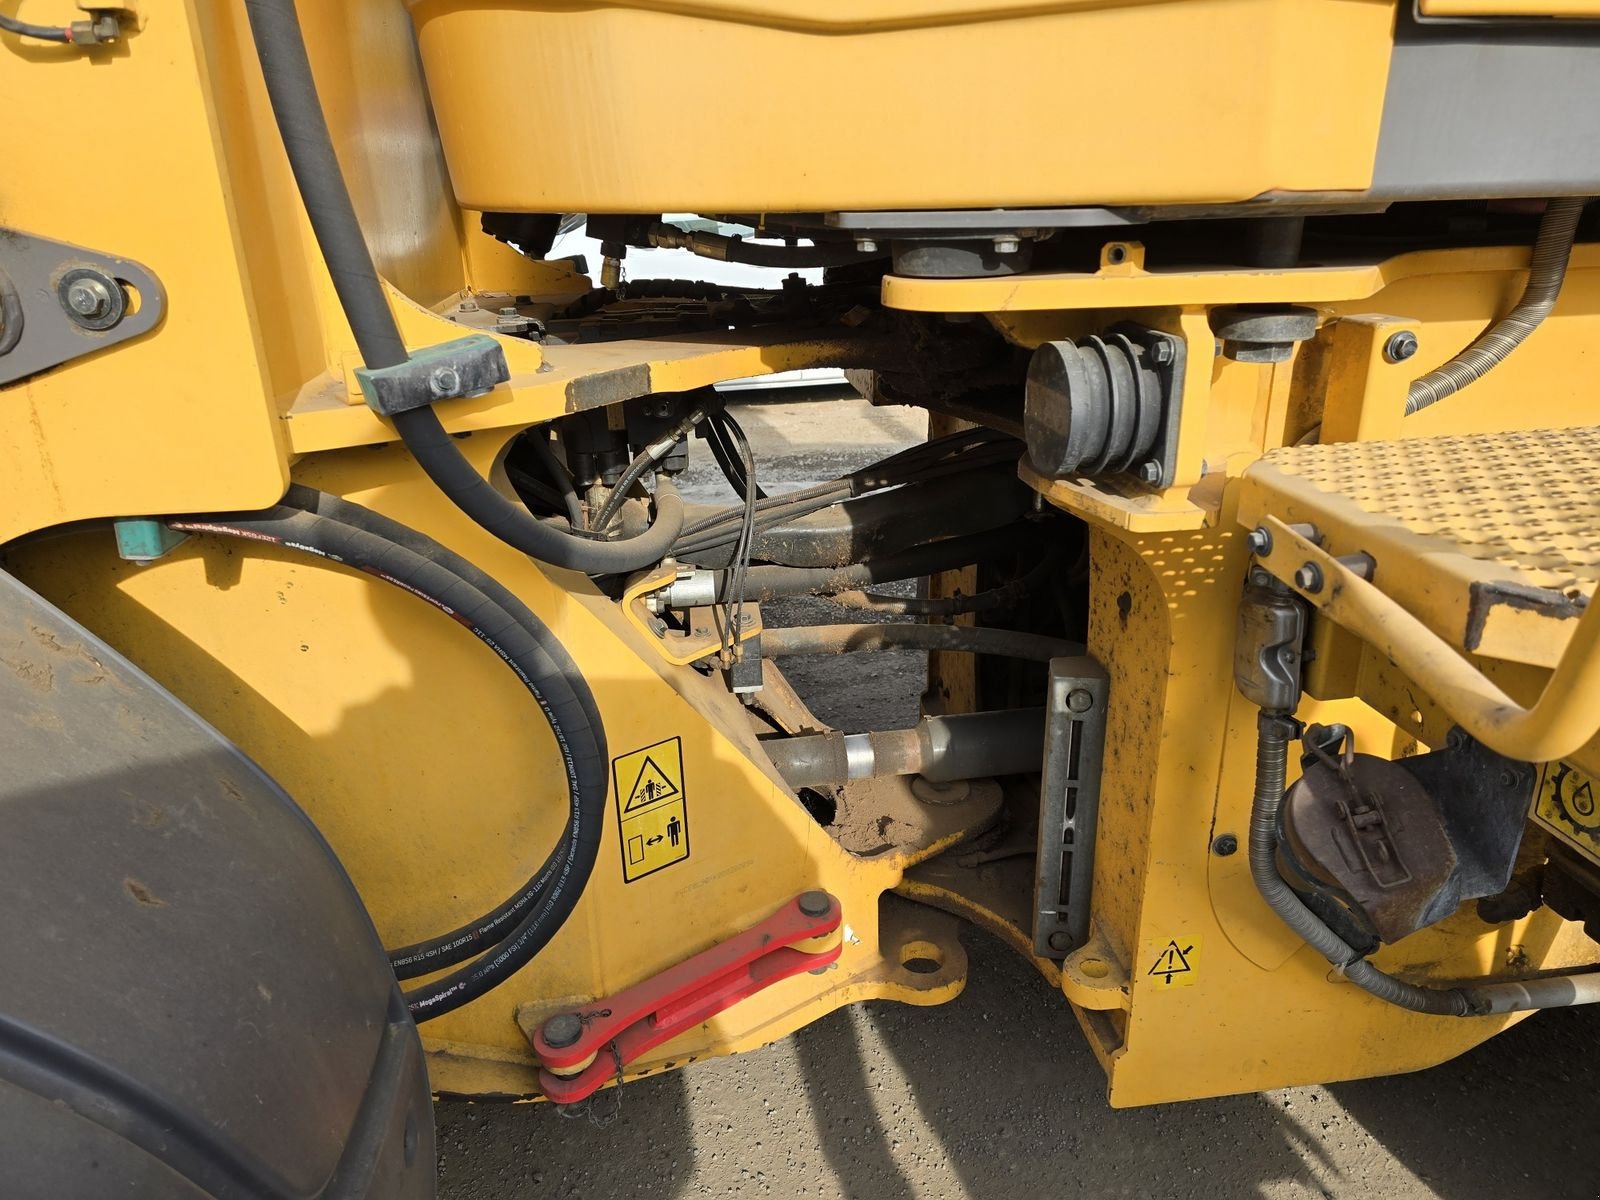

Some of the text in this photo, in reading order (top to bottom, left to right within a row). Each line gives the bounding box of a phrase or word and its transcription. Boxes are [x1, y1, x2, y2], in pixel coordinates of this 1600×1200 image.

[508, 658, 531, 683] Resistant
[568, 838, 578, 861] Exceeds
[393, 956, 413, 967] EN856
[413, 954, 425, 962] R15
[425, 948, 438, 958] 4SH
[441, 943, 453, 953] SAE
[453, 934, 473, 948] 100R15
[478, 921, 495, 935] Flame
[494, 907, 516, 926] Resistant
[514, 896, 528, 910] MSHA
[526, 881, 543, 900] 2G-11C
[540, 869, 553, 884] Meets
